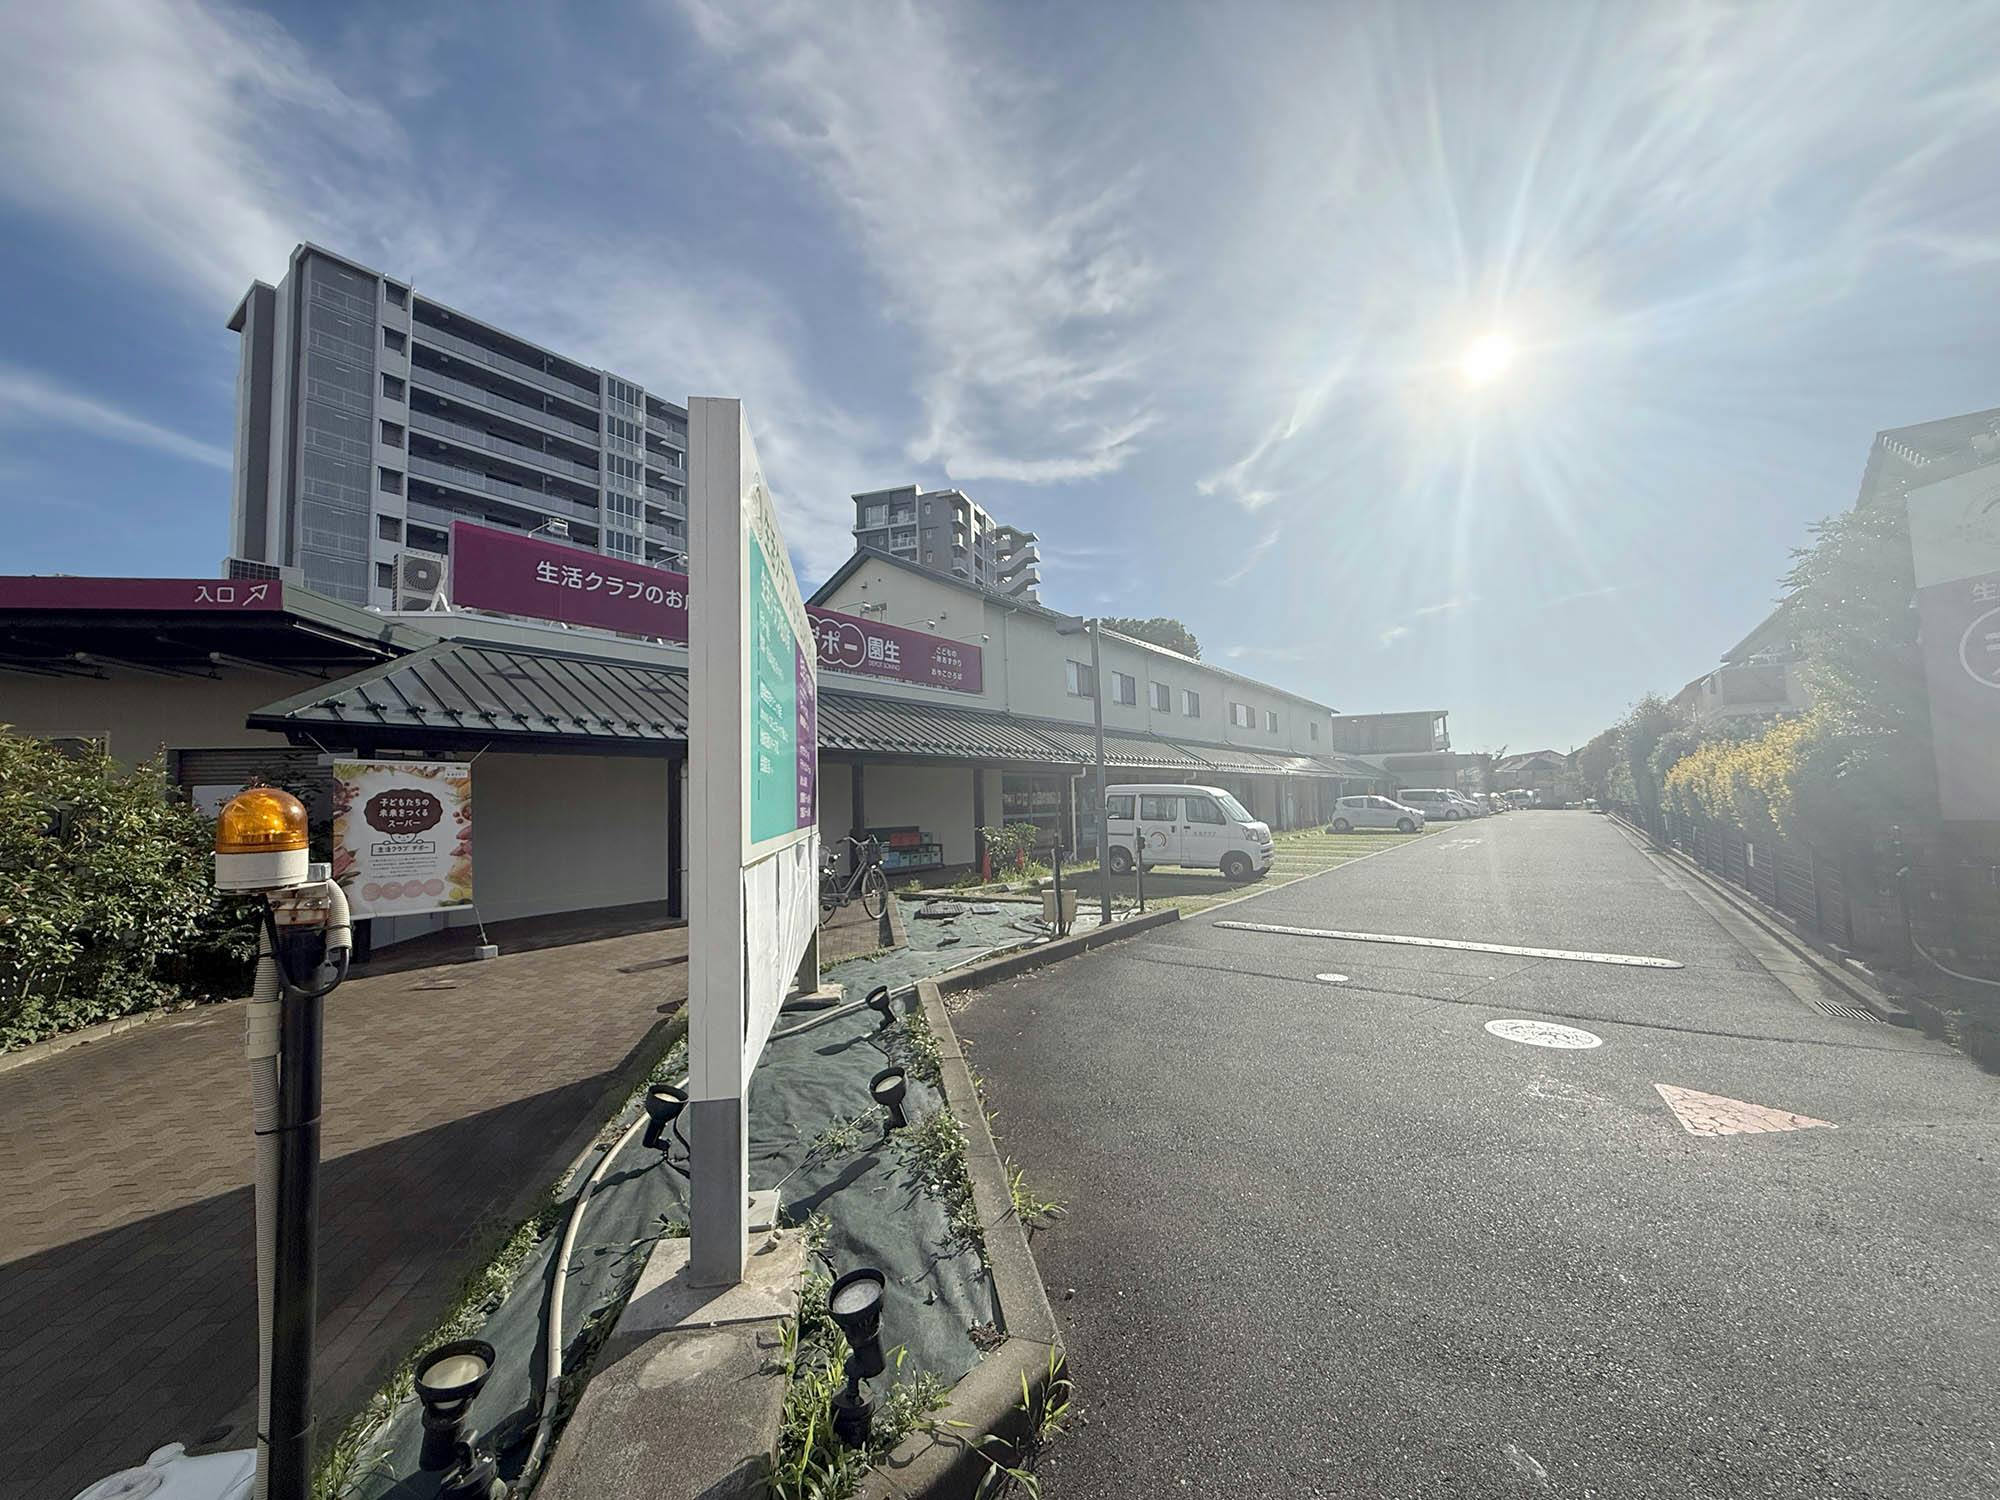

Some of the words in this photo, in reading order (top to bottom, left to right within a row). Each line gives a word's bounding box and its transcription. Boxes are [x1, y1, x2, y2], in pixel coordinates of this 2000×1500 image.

[535, 560, 688, 610] 生活クラブのお
[194, 586, 235, 603] 入口
[867, 636, 901, 664] 園生
[379, 798, 430, 807] 子どもたちの
[378, 808, 429, 818] 未来をつくる
[387, 819, 421, 828] スーパー
